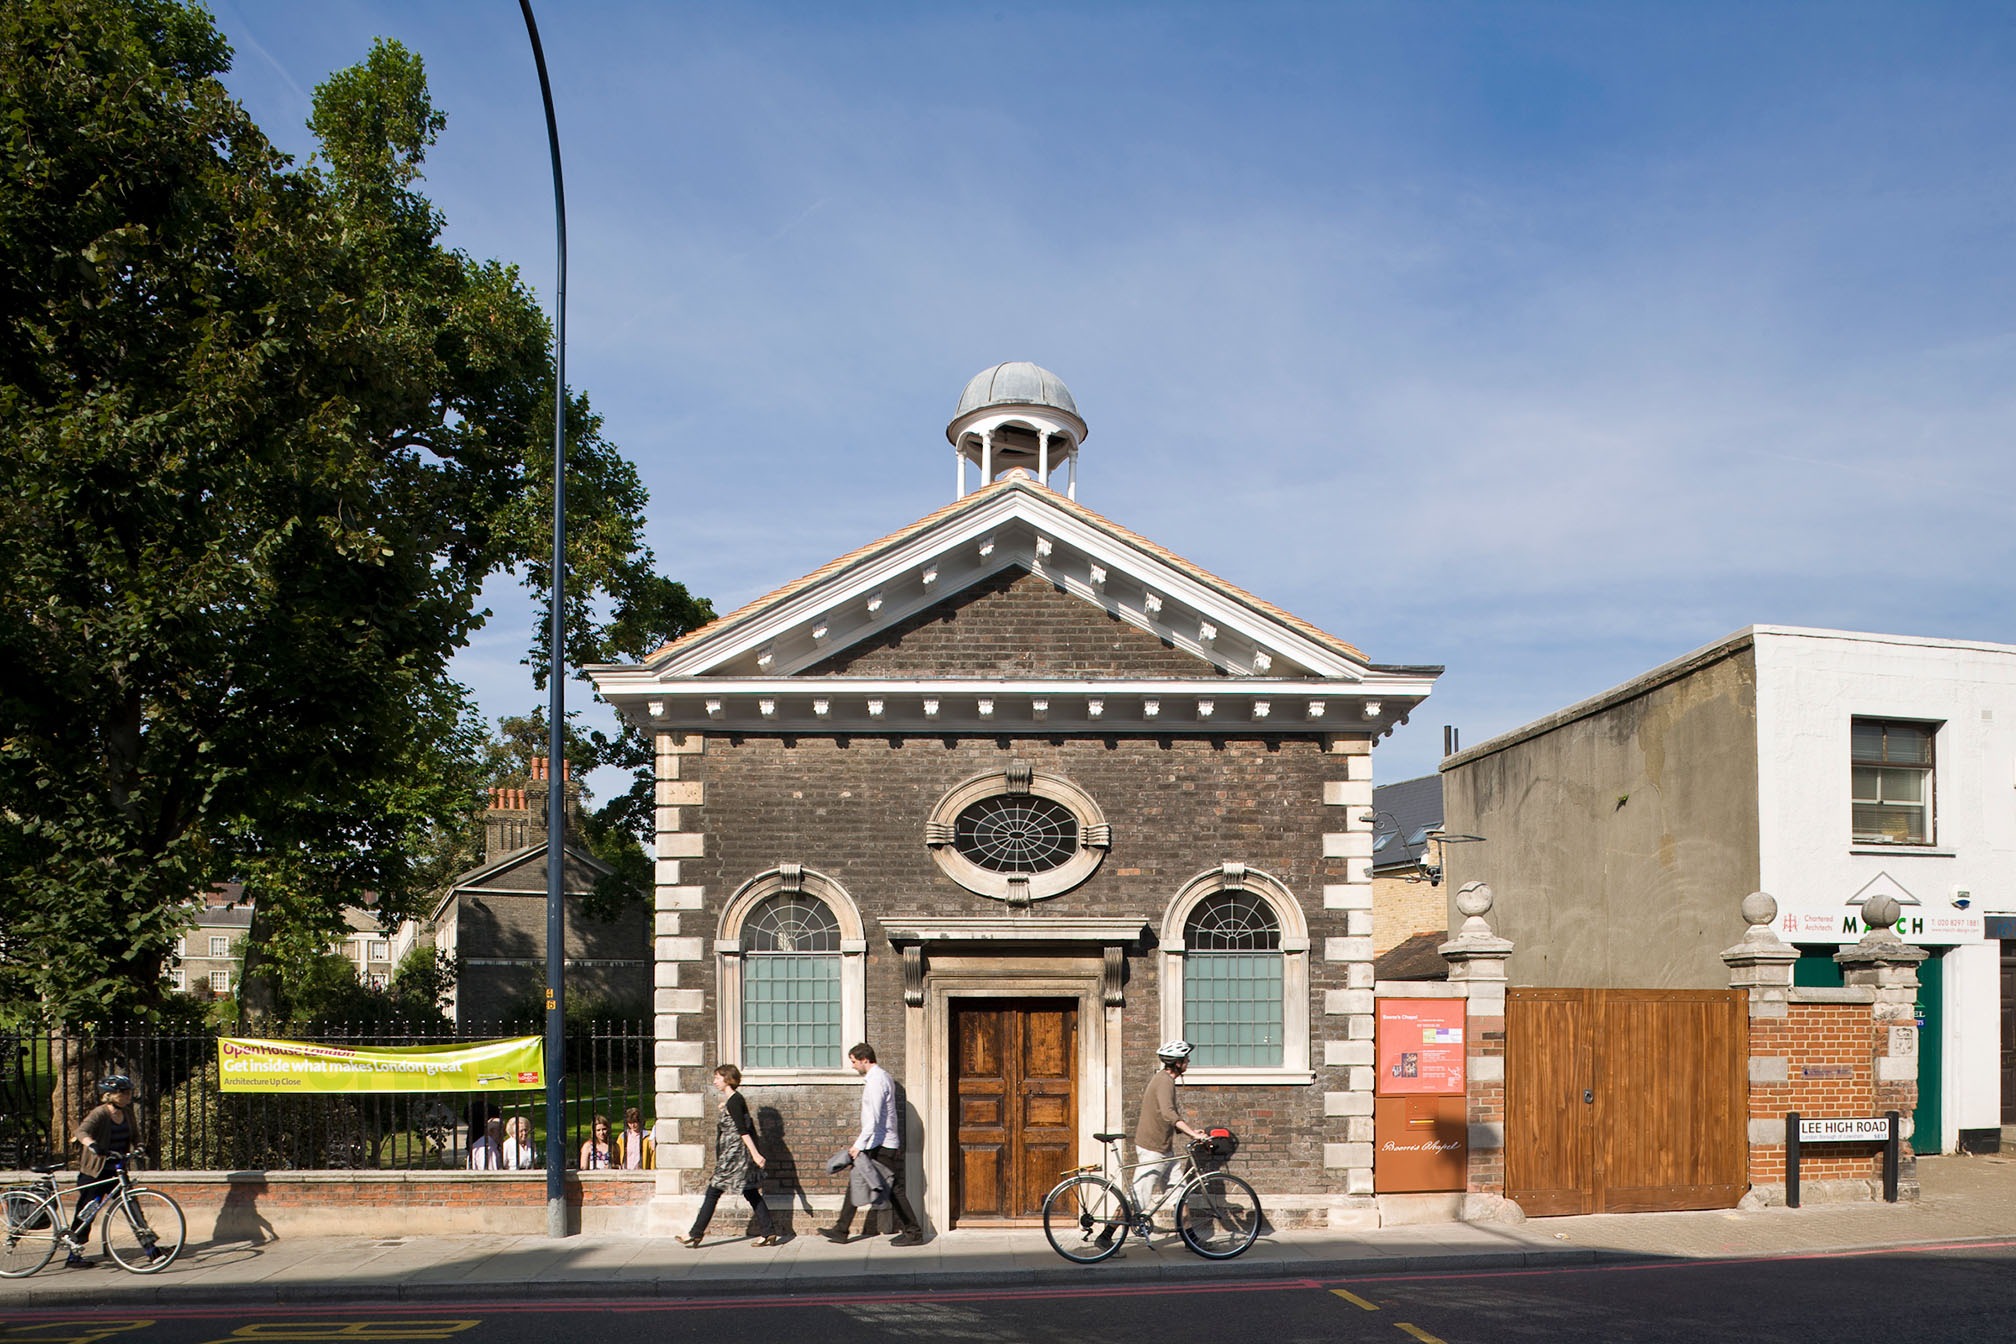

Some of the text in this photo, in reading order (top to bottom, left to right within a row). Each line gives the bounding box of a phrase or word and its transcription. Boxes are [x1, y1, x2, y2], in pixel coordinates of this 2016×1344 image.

[1804, 914, 1834, 922] Chartered
[1937, 919, 1949, 927] 020
[1950, 919, 1965, 927] 8297
[1966, 919, 1980, 927] 1881
[1842, 916, 1923, 934] MCH
[223, 1042, 260, 1058] Open
[261, 1045, 302, 1056] House
[223, 1058, 463, 1076] Get inside what makes London great
[223, 1077, 302, 1088] Architecture Up Close
[1801, 1121, 1887, 1134] LEE HIGH ROAD
